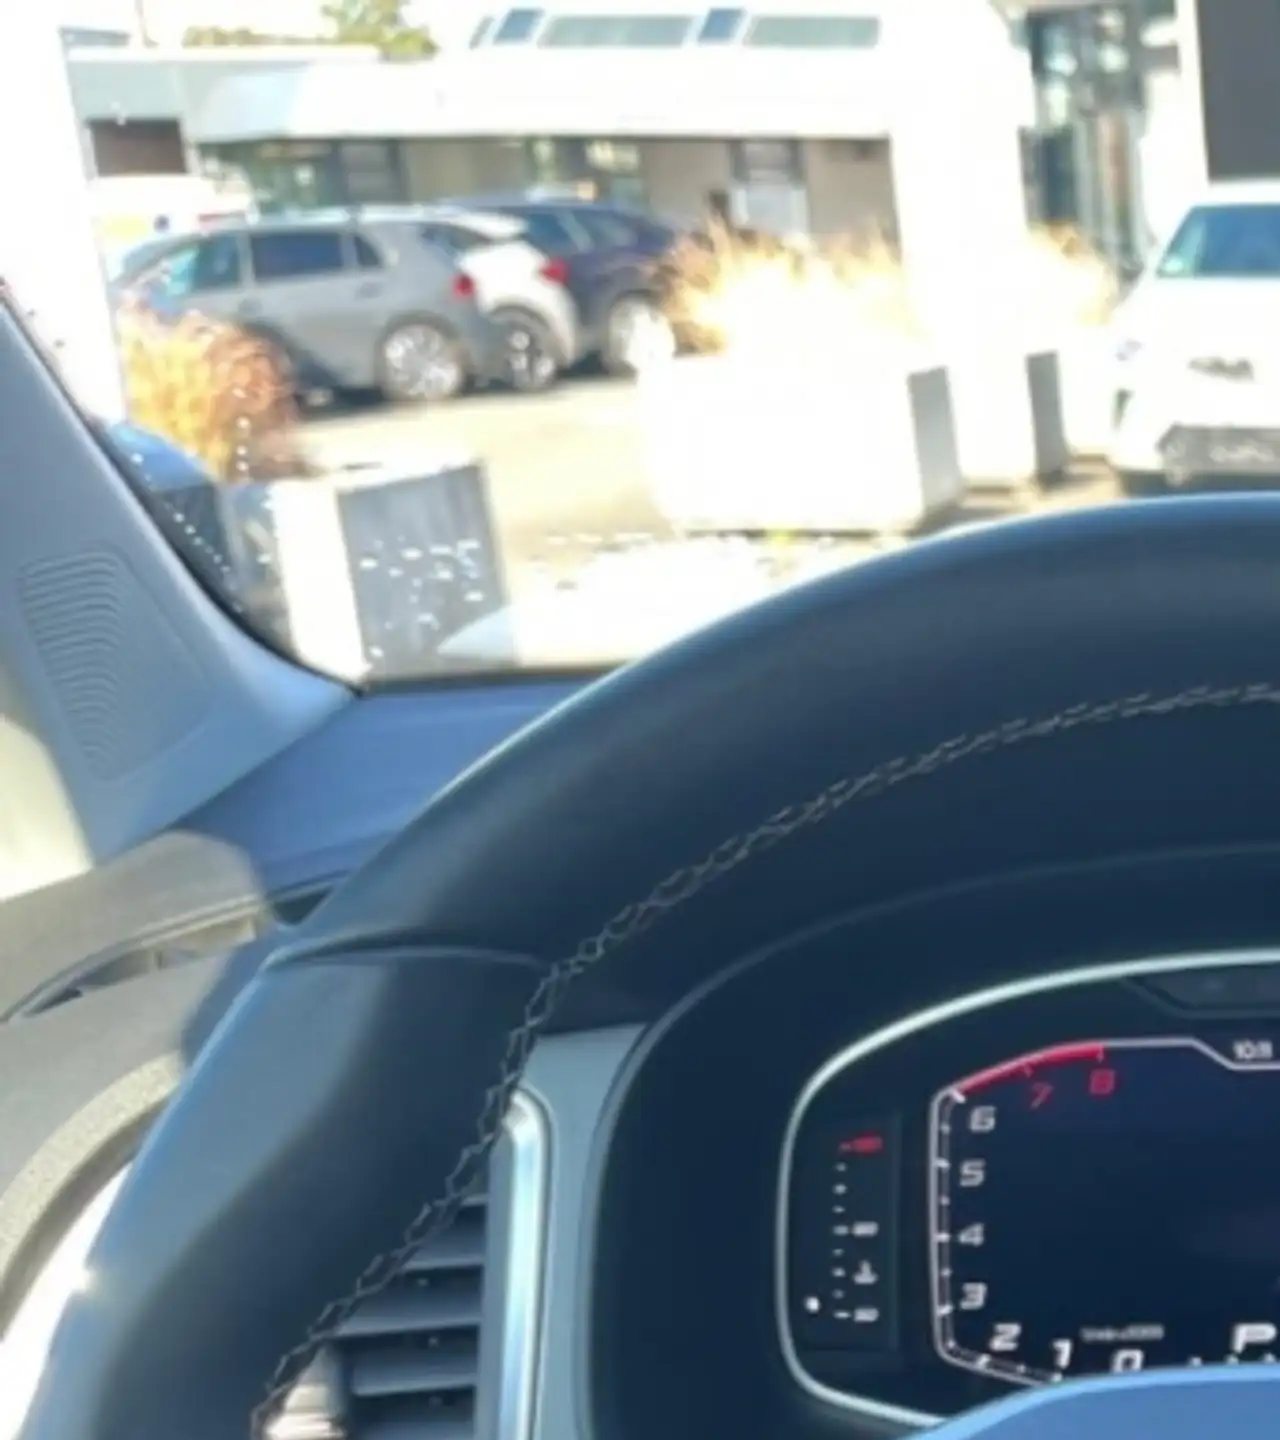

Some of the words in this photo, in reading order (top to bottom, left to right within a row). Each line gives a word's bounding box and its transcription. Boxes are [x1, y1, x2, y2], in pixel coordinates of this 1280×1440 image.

[1030, 1083, 1053, 1108] 7
[1089, 1069, 1116, 1095] 8
[968, 1105, 996, 1133] 6
[960, 1158, 986, 1187] 5
[958, 1223, 985, 1246] 4
[959, 1281, 988, 1310] 3
[990, 1322, 1022, 1352] 2
[1231, 1322, 1279, 1354] P
[1052, 1338, 1073, 1369] 1
